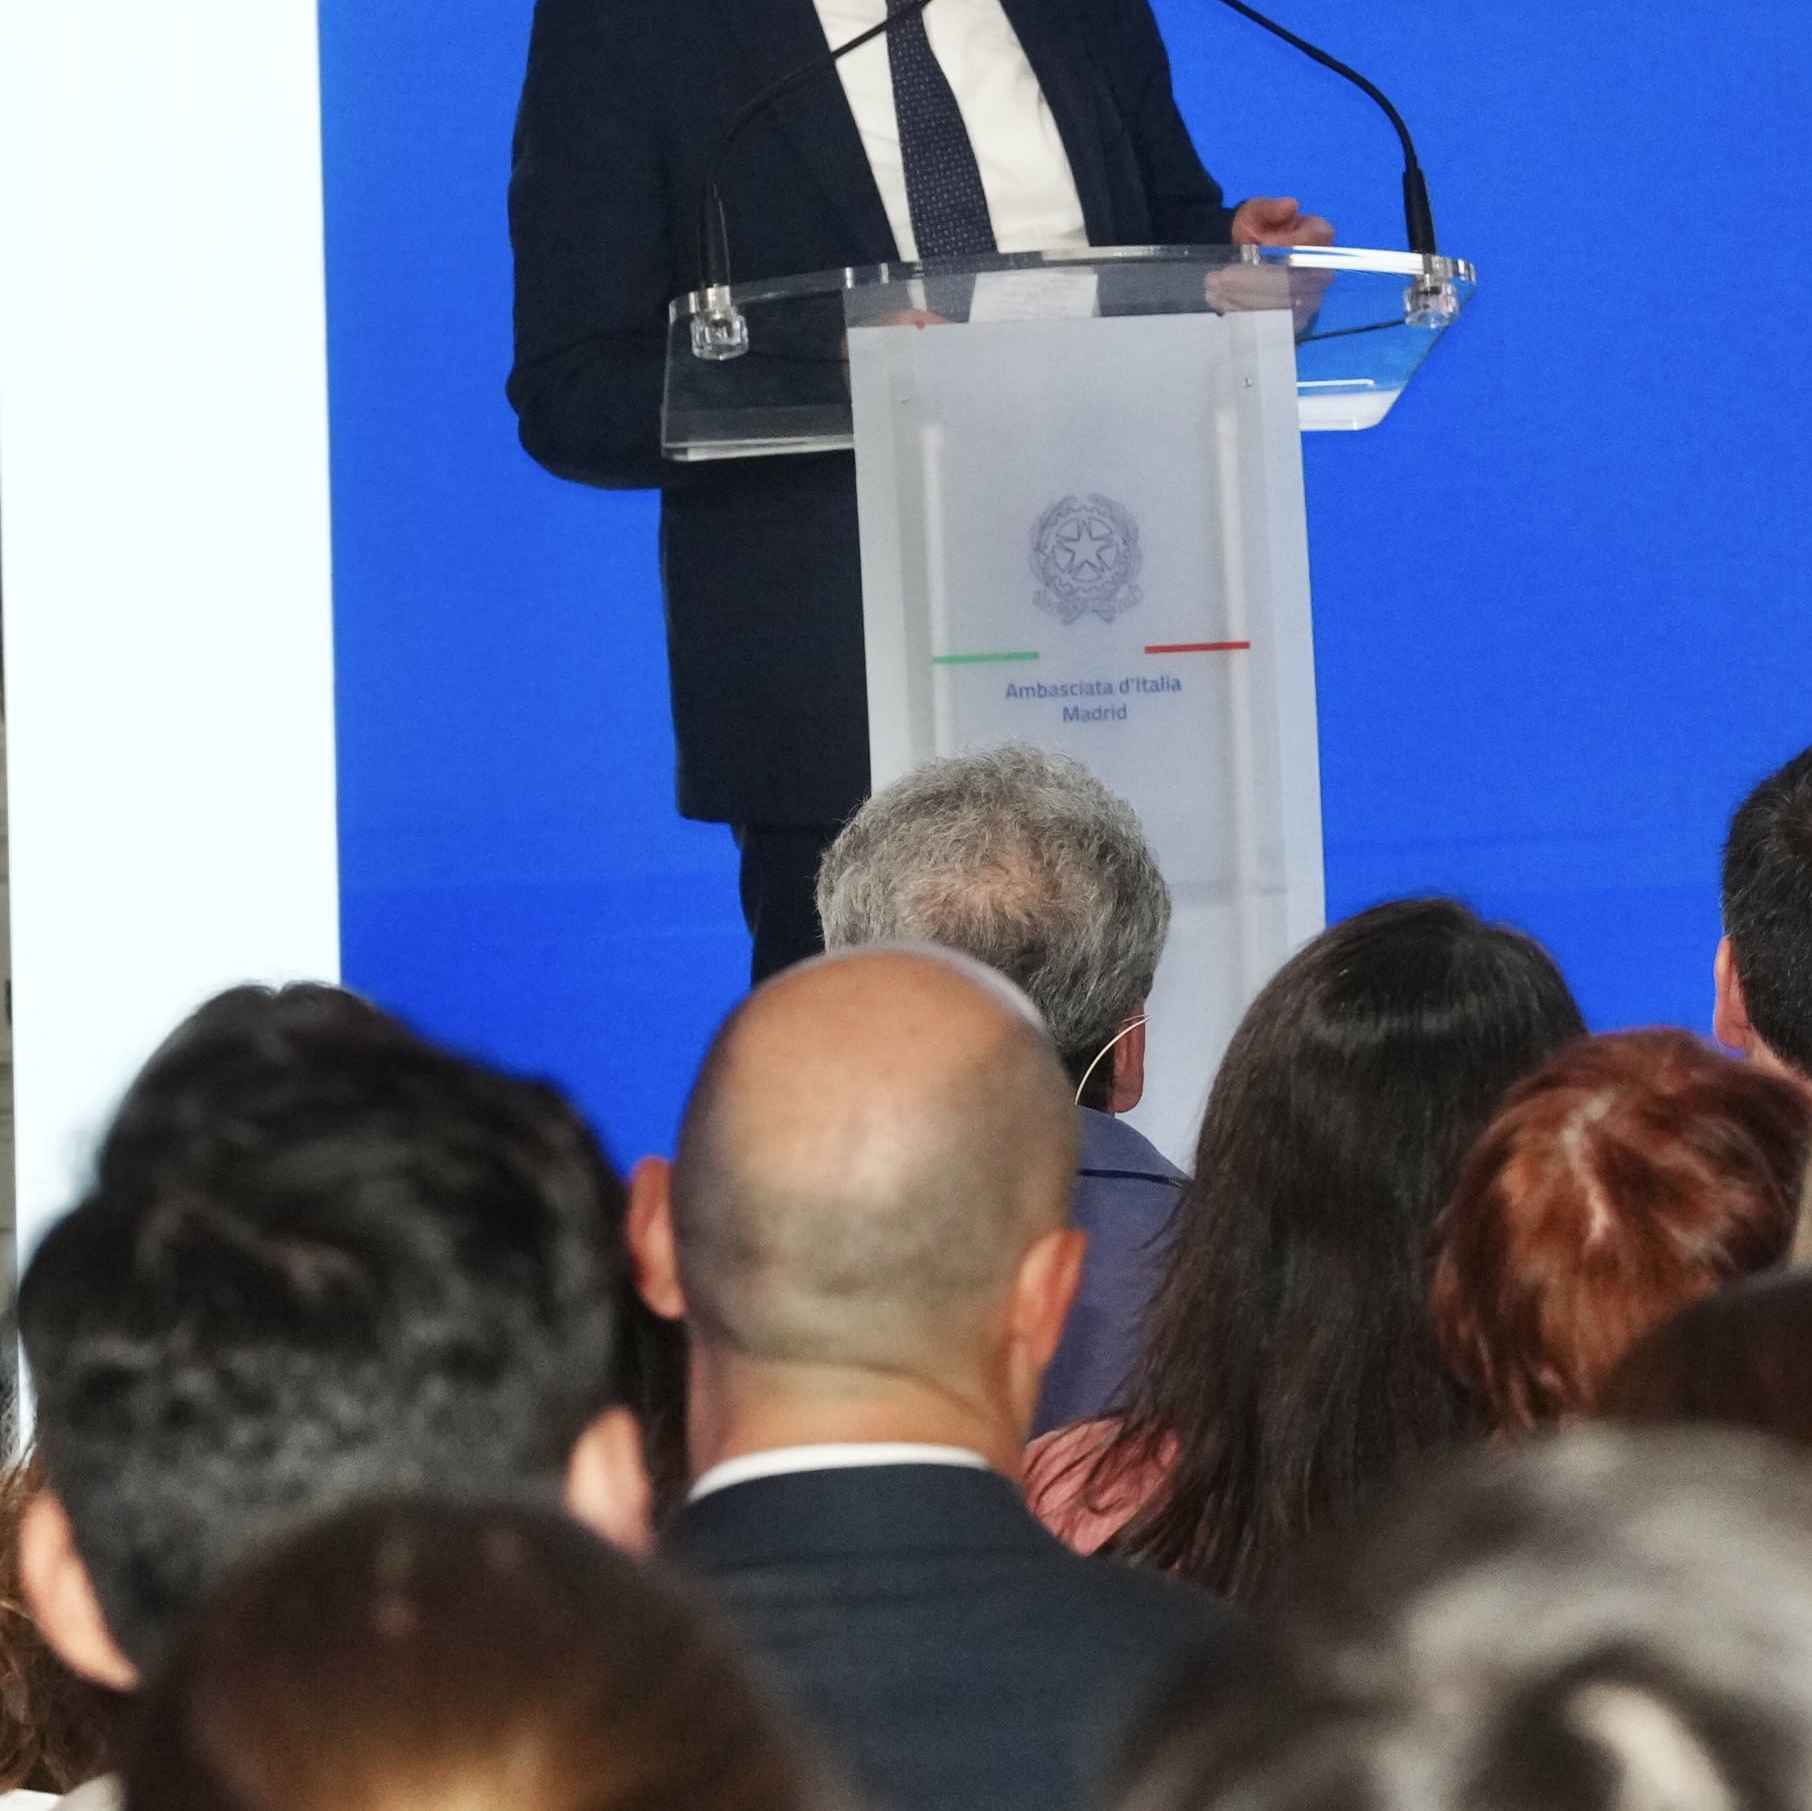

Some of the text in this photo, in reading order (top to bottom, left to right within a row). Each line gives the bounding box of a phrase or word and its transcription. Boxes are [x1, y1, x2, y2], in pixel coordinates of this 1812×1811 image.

[1005, 674, 1182, 699] Ambasciata d'Italia
[1062, 703, 1128, 723] Madrid
